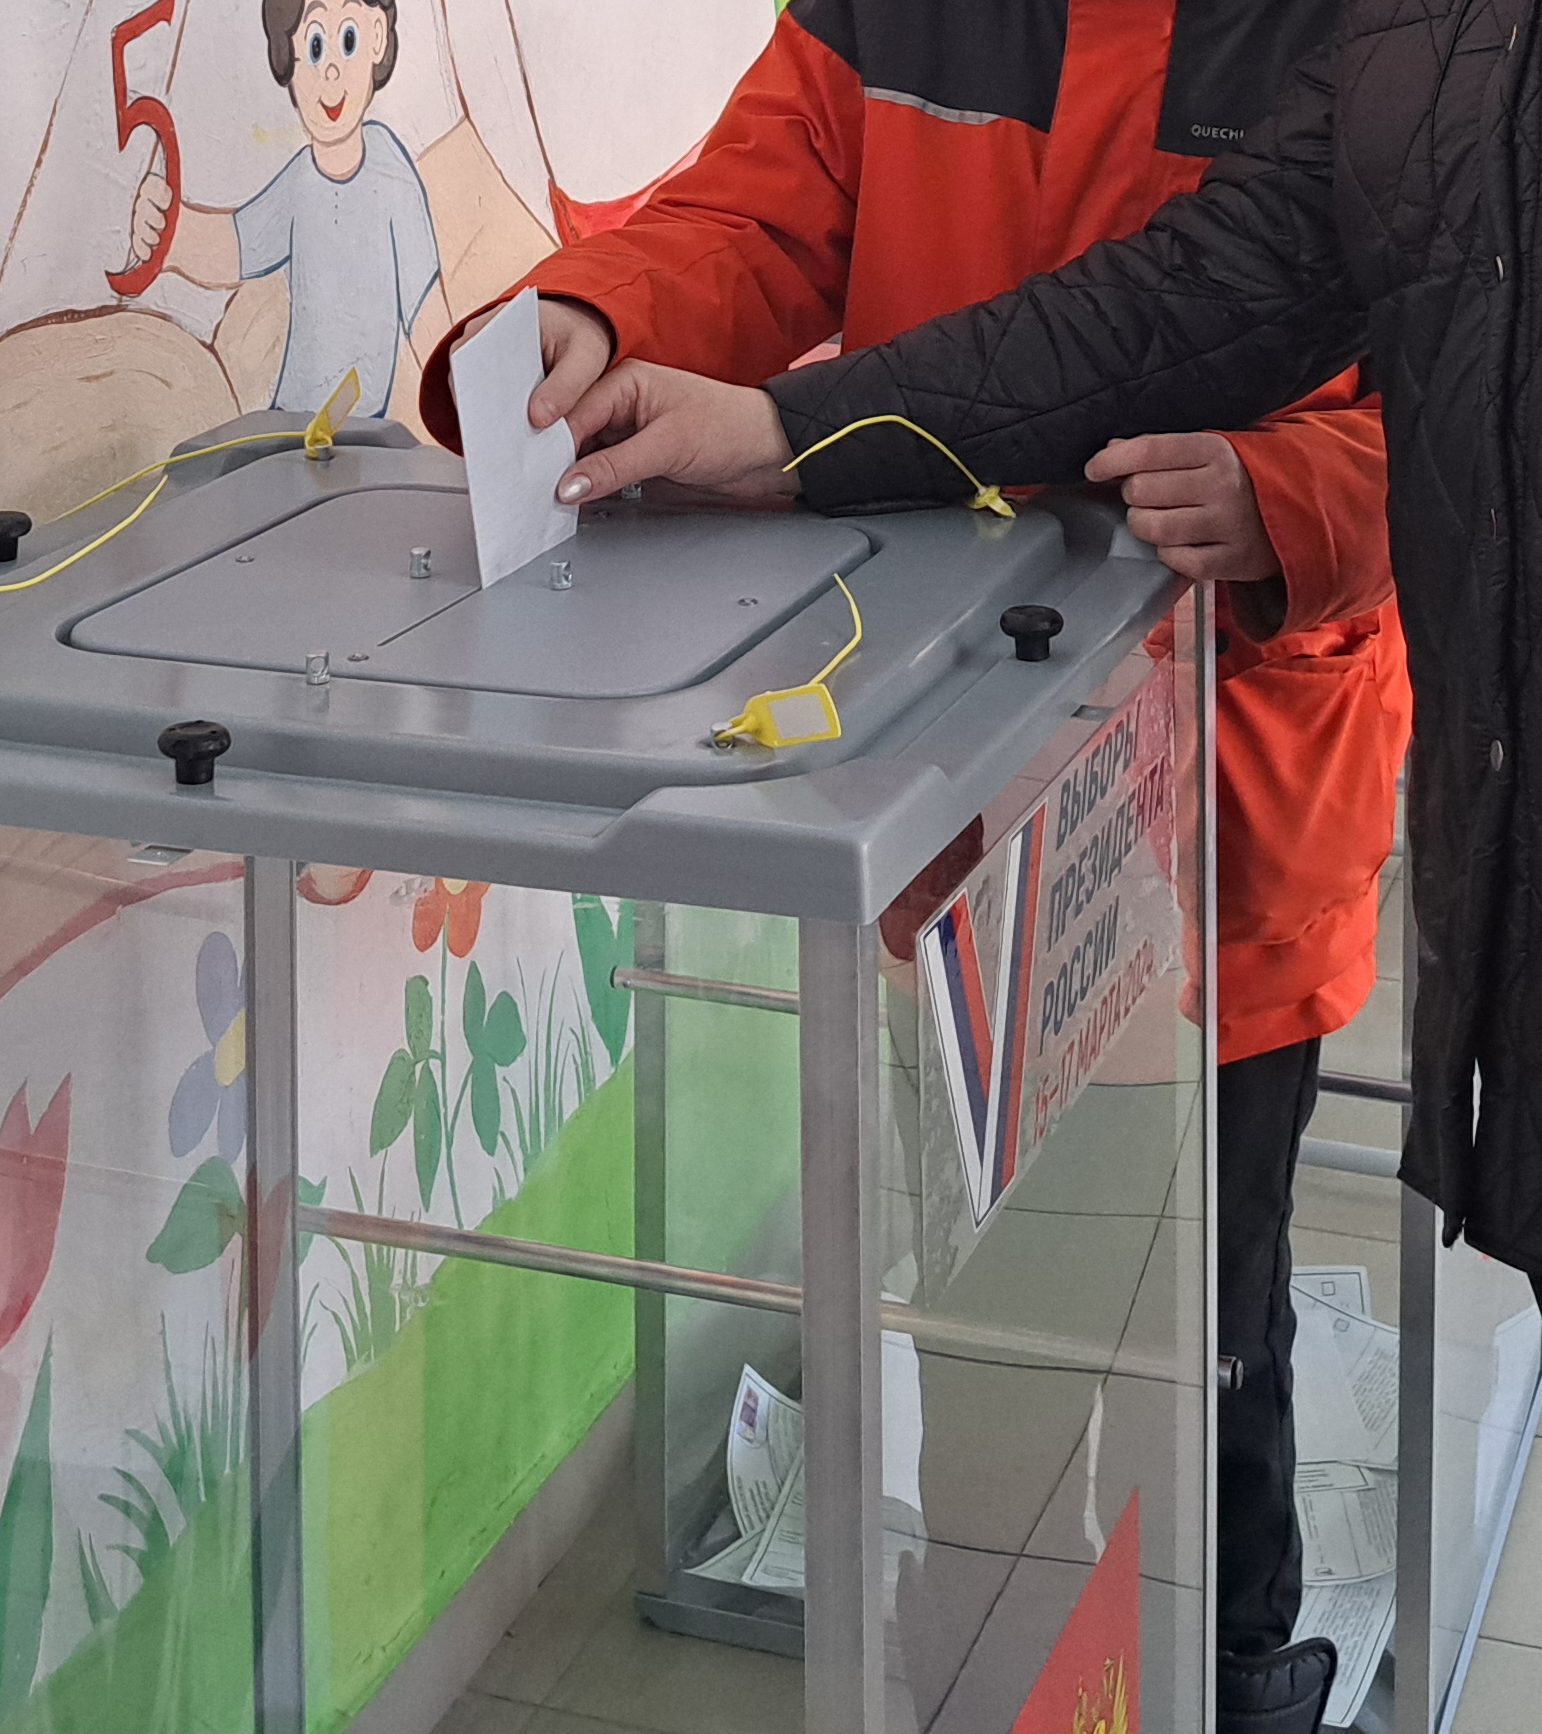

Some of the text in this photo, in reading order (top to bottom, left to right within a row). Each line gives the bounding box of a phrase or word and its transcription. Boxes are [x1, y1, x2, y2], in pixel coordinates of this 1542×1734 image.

[1056, 695, 1142, 851] ВЫБОРЫ
[1047, 754, 1165, 953] ПРЕЗИДЕНТА
[1039, 895, 1119, 1057] РОССИИ
[1075, 975, 1121, 1087] МАРТА
